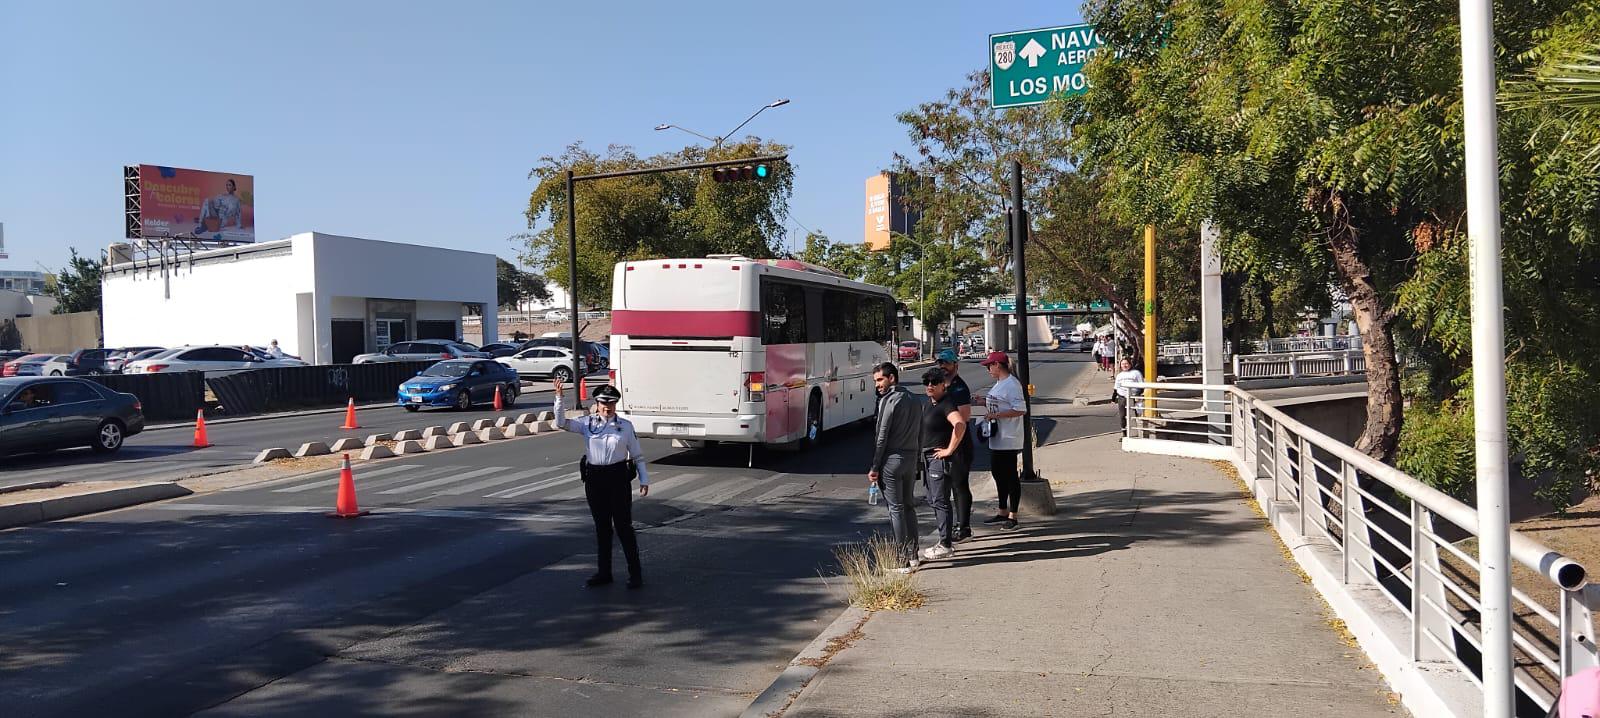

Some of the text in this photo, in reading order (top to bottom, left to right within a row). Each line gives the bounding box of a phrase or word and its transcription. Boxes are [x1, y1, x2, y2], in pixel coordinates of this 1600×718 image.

[998, 51, 1013, 64] 280
[1009, 77, 1047, 97] LOS
[144, 180, 200, 194] Descubre
